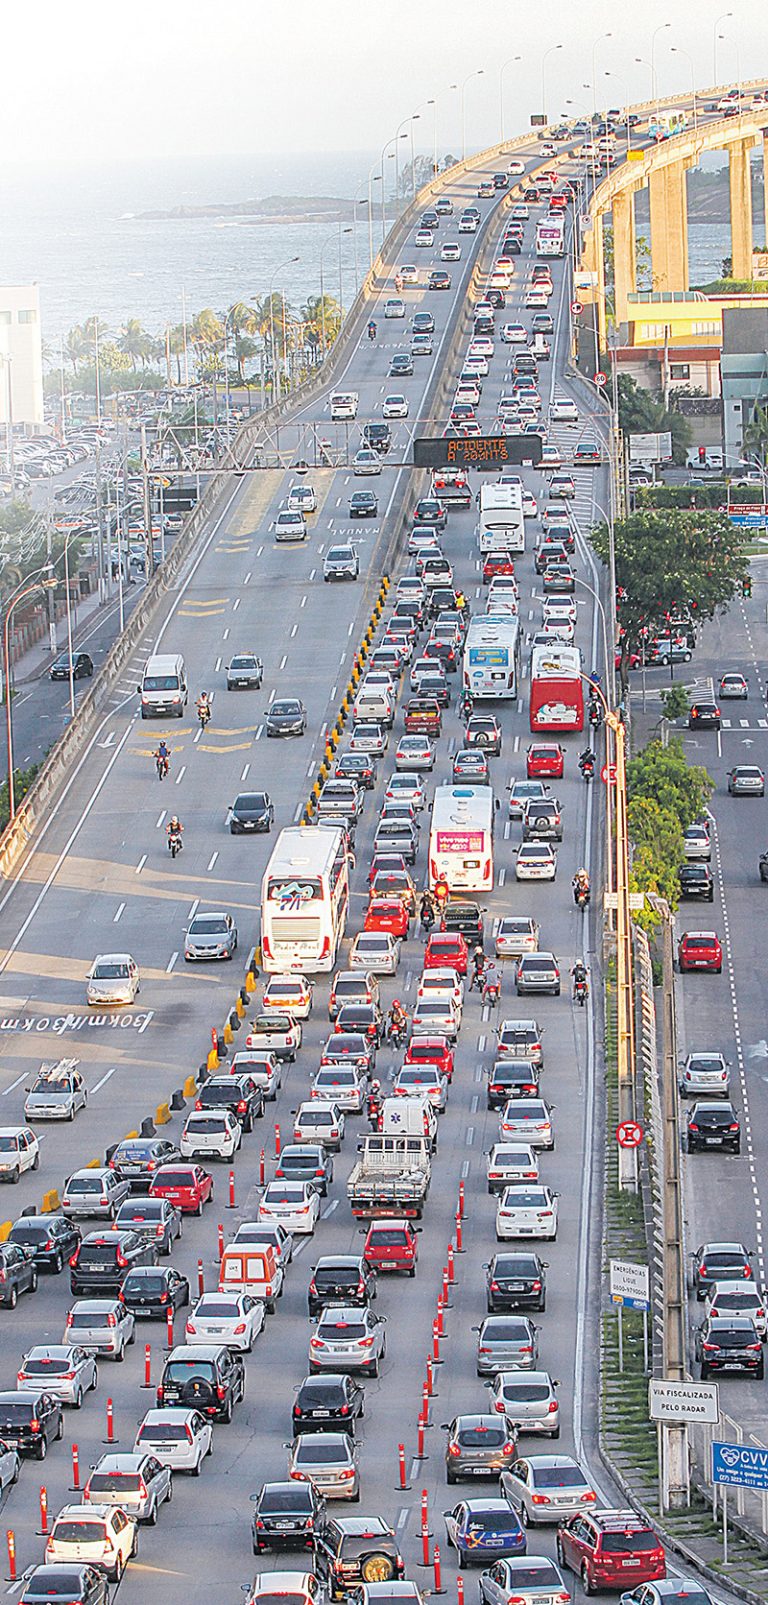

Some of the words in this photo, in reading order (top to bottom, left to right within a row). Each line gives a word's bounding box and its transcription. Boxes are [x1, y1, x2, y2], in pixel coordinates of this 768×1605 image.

[448, 439, 507, 452] ACIDENTE
[447, 451, 456, 462] A
[330, 527, 380, 536] MANUAL
[613, 1265, 646, 1277] EMERGÊNCIAS
[622, 1276, 637, 1285] LIGUE
[653, 1388, 665, 1396] VIA
[667, 1389, 713, 1400] FISCALIZADA
[661, 1403, 680, 1412] PELO
[681, 1405, 706, 1414] RADAR
[740, 1450, 768, 1466] CVV
